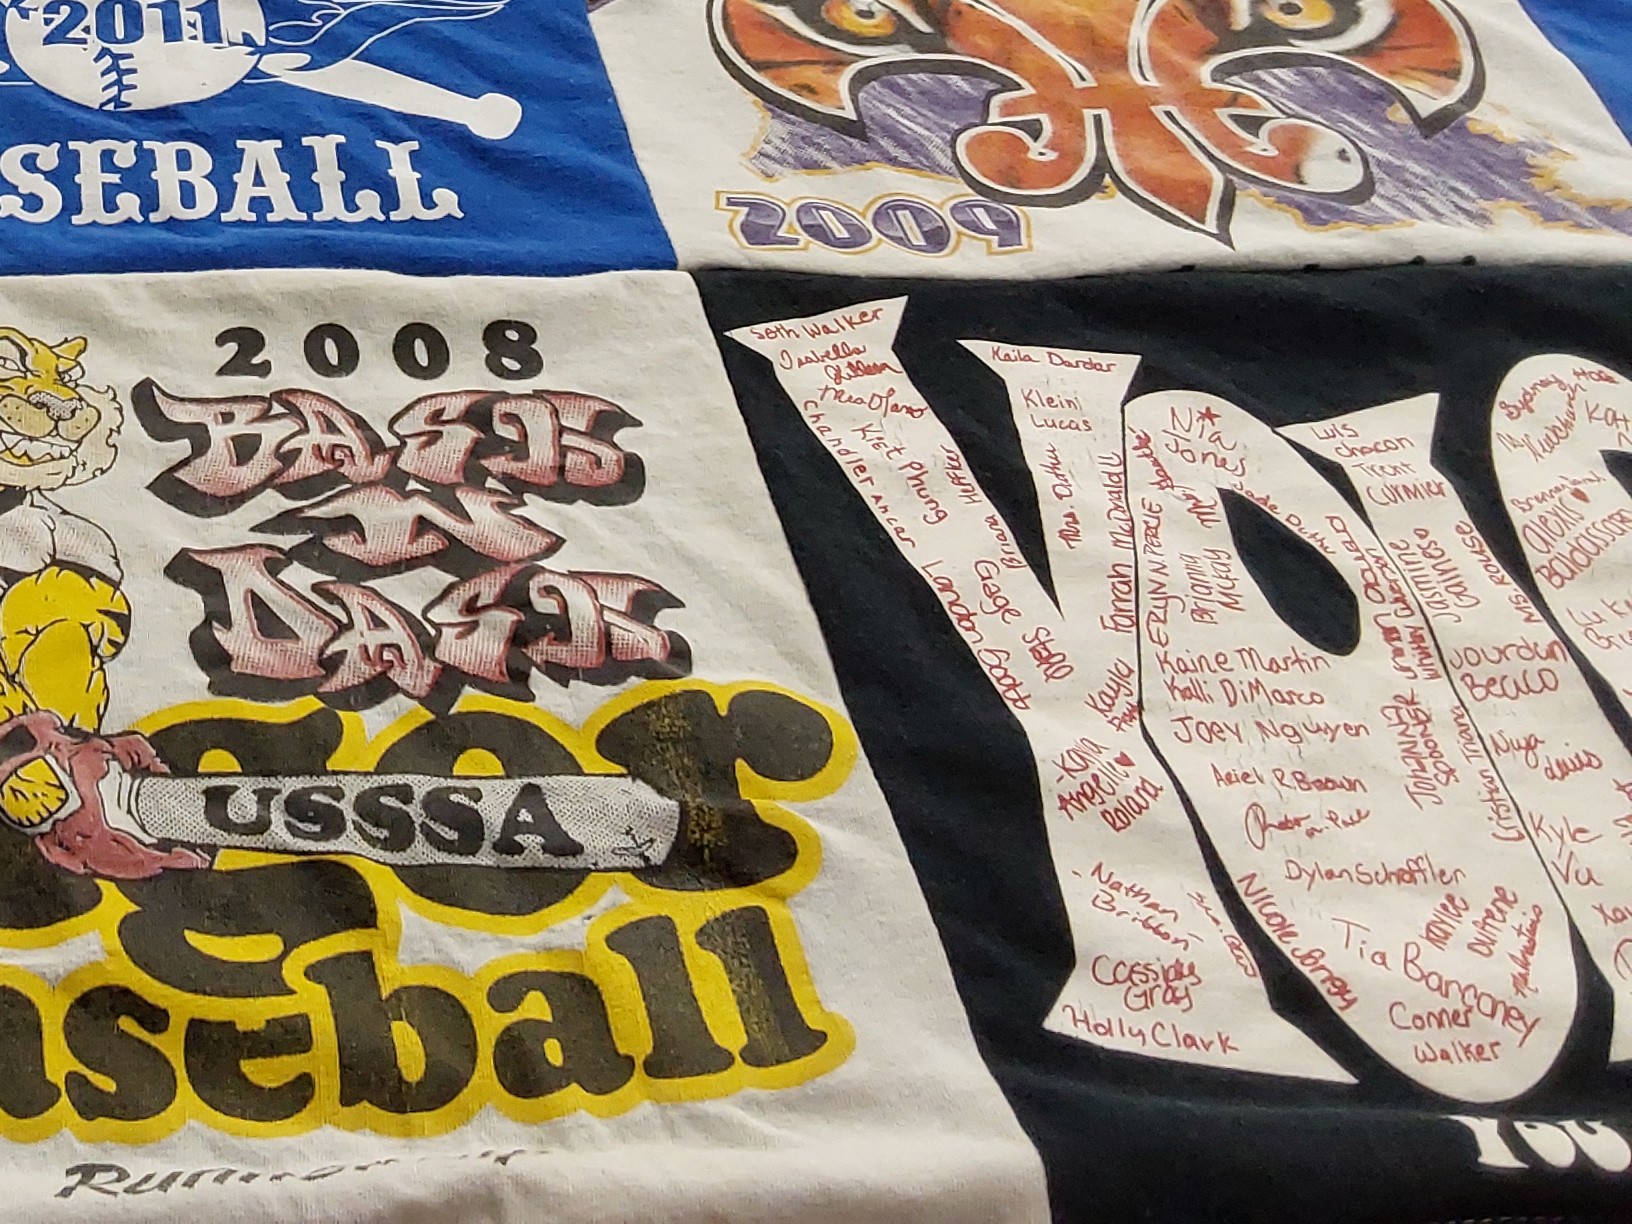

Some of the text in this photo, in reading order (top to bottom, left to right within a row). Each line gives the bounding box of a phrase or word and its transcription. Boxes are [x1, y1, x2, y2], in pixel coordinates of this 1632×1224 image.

[715, 188, 1034, 258] 2009
[802, 307, 885, 339] Walker
[214, 318, 546, 381] 2008
[1029, 413, 1093, 432] Lucas
[1099, 561, 1136, 634] Farrah
[1236, 645, 1332, 675] Martin
[1218, 678, 1326, 708] DiMarco
[200, 779, 588, 860] USSSA
[1150, 1021, 1240, 1056] Clark
[1412, 1038, 1503, 1067] Walker
